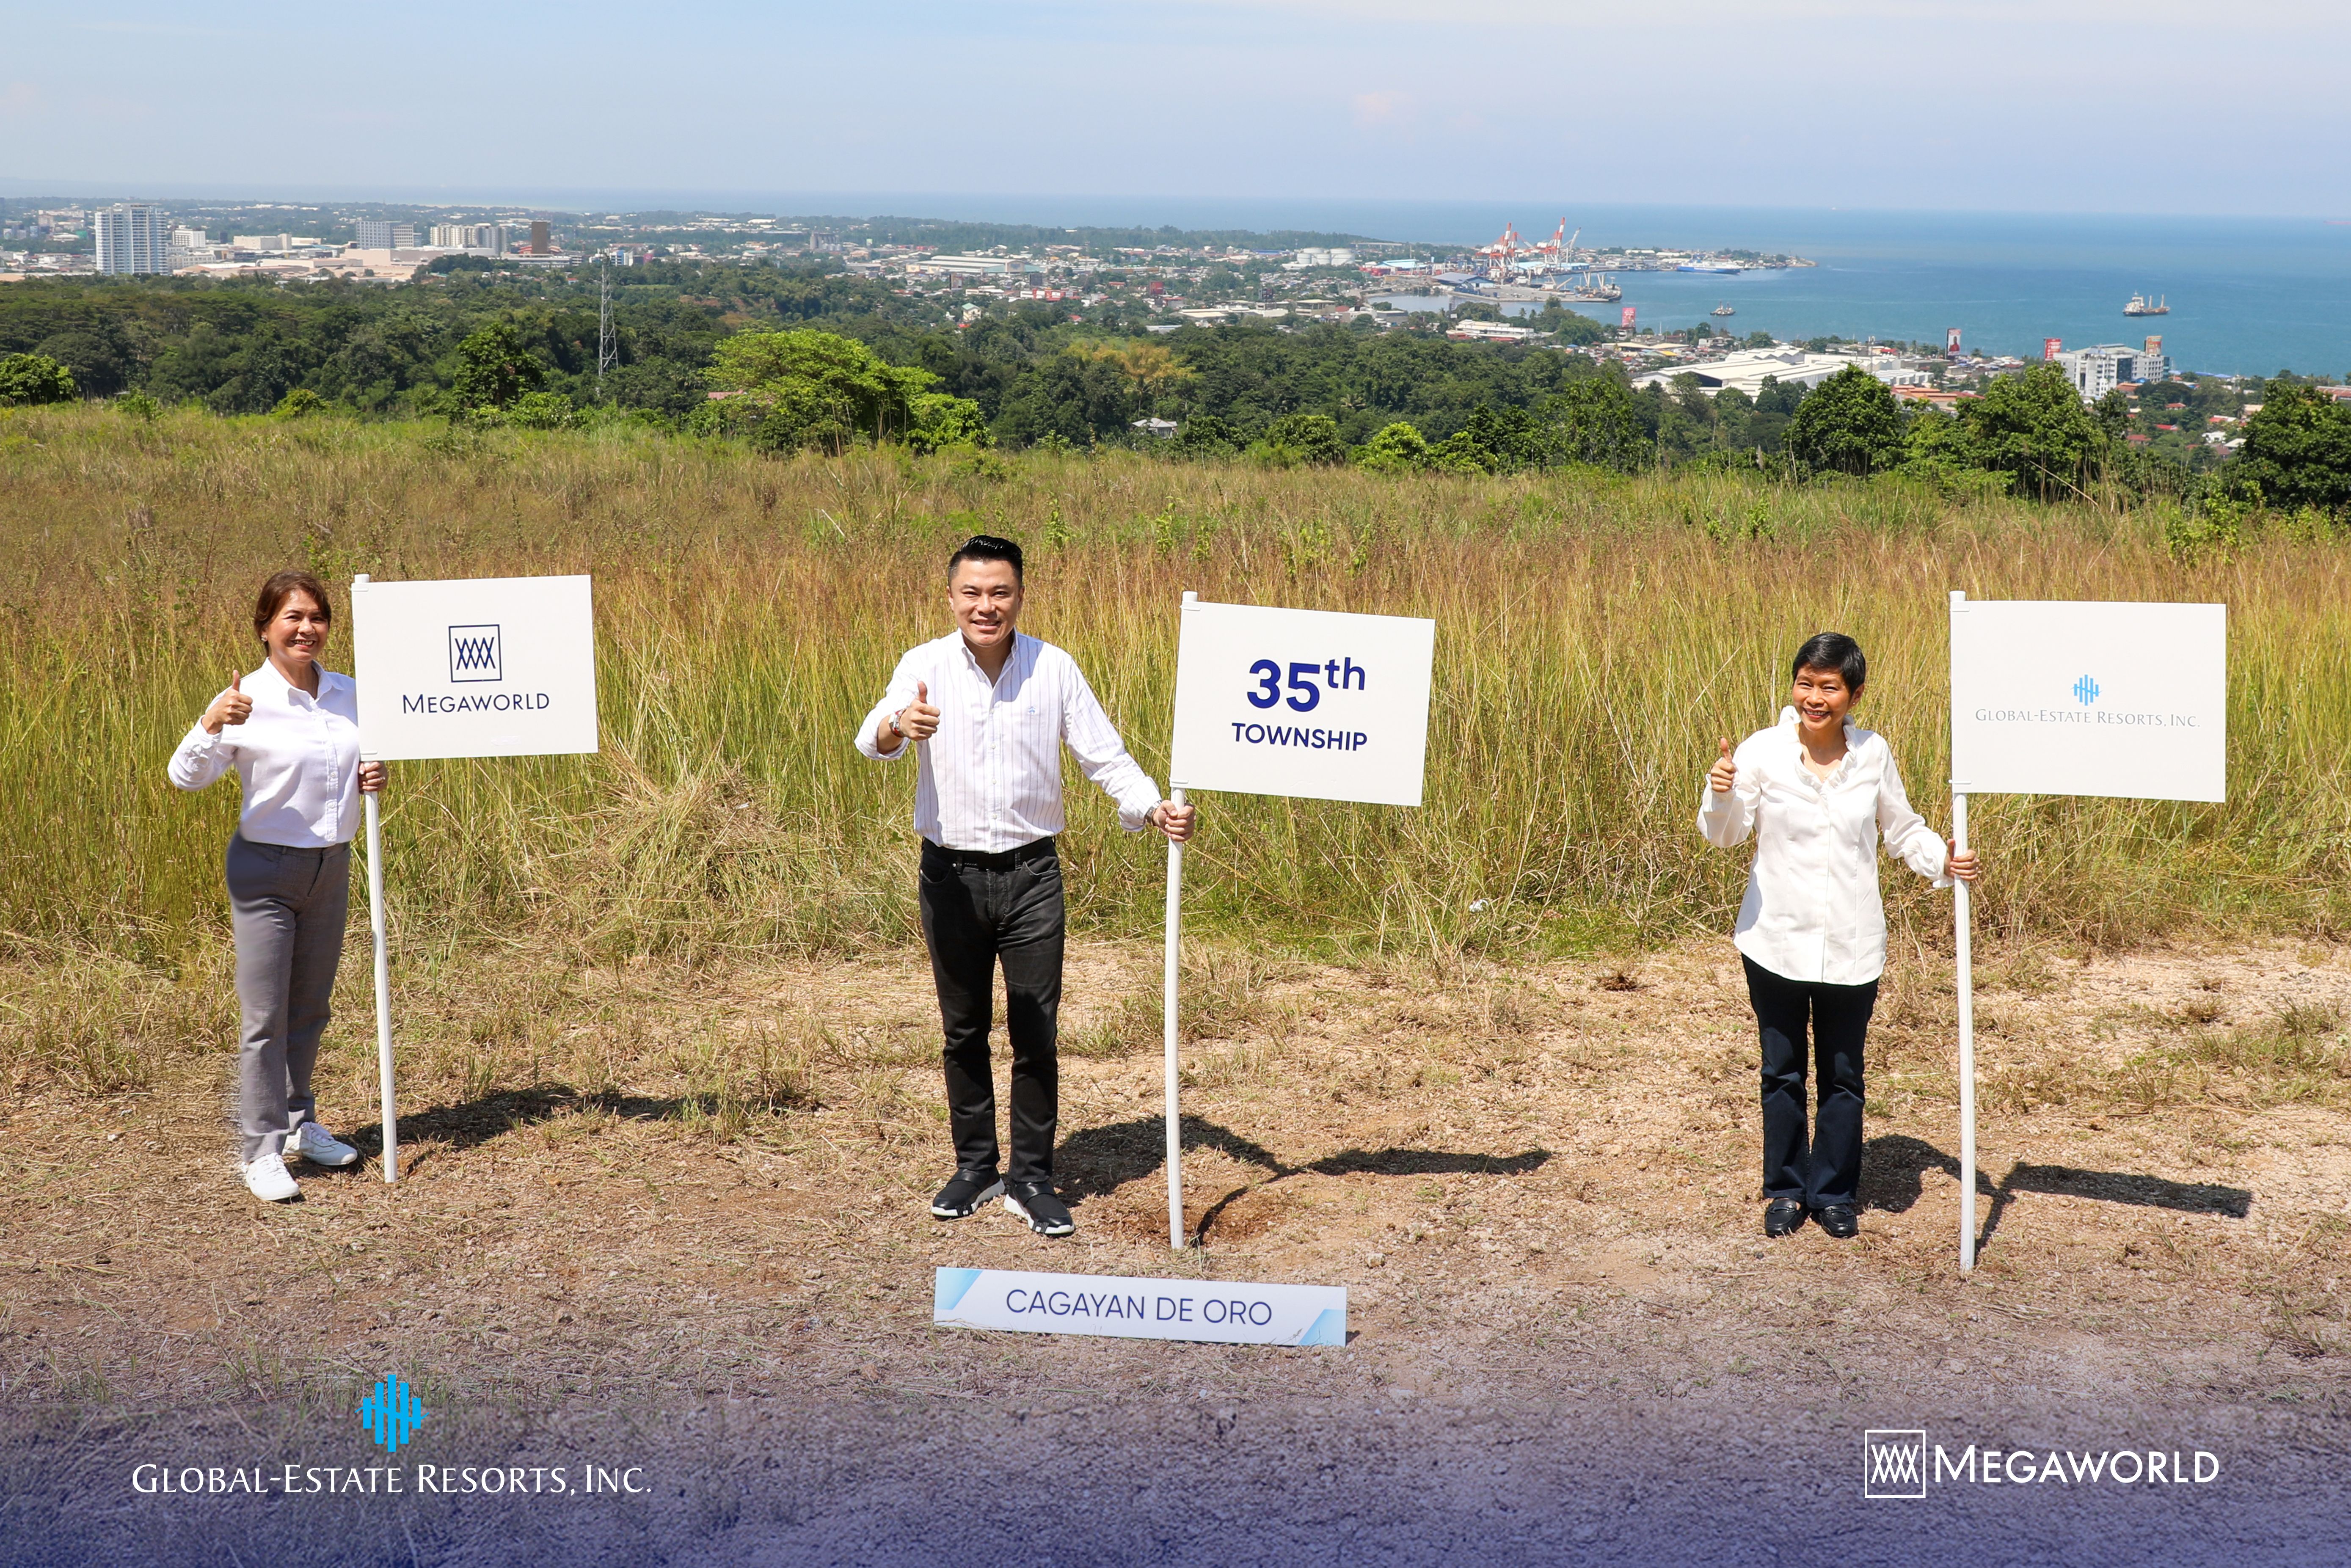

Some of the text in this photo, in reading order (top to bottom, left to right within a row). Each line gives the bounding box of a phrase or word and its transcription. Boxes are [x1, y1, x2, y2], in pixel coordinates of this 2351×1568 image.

[1247, 657, 1365, 712] 35th
[1231, 722, 1367, 751] TOWNSHIP
[1006, 1289, 1272, 1325] CAGAYAN DE ORO
